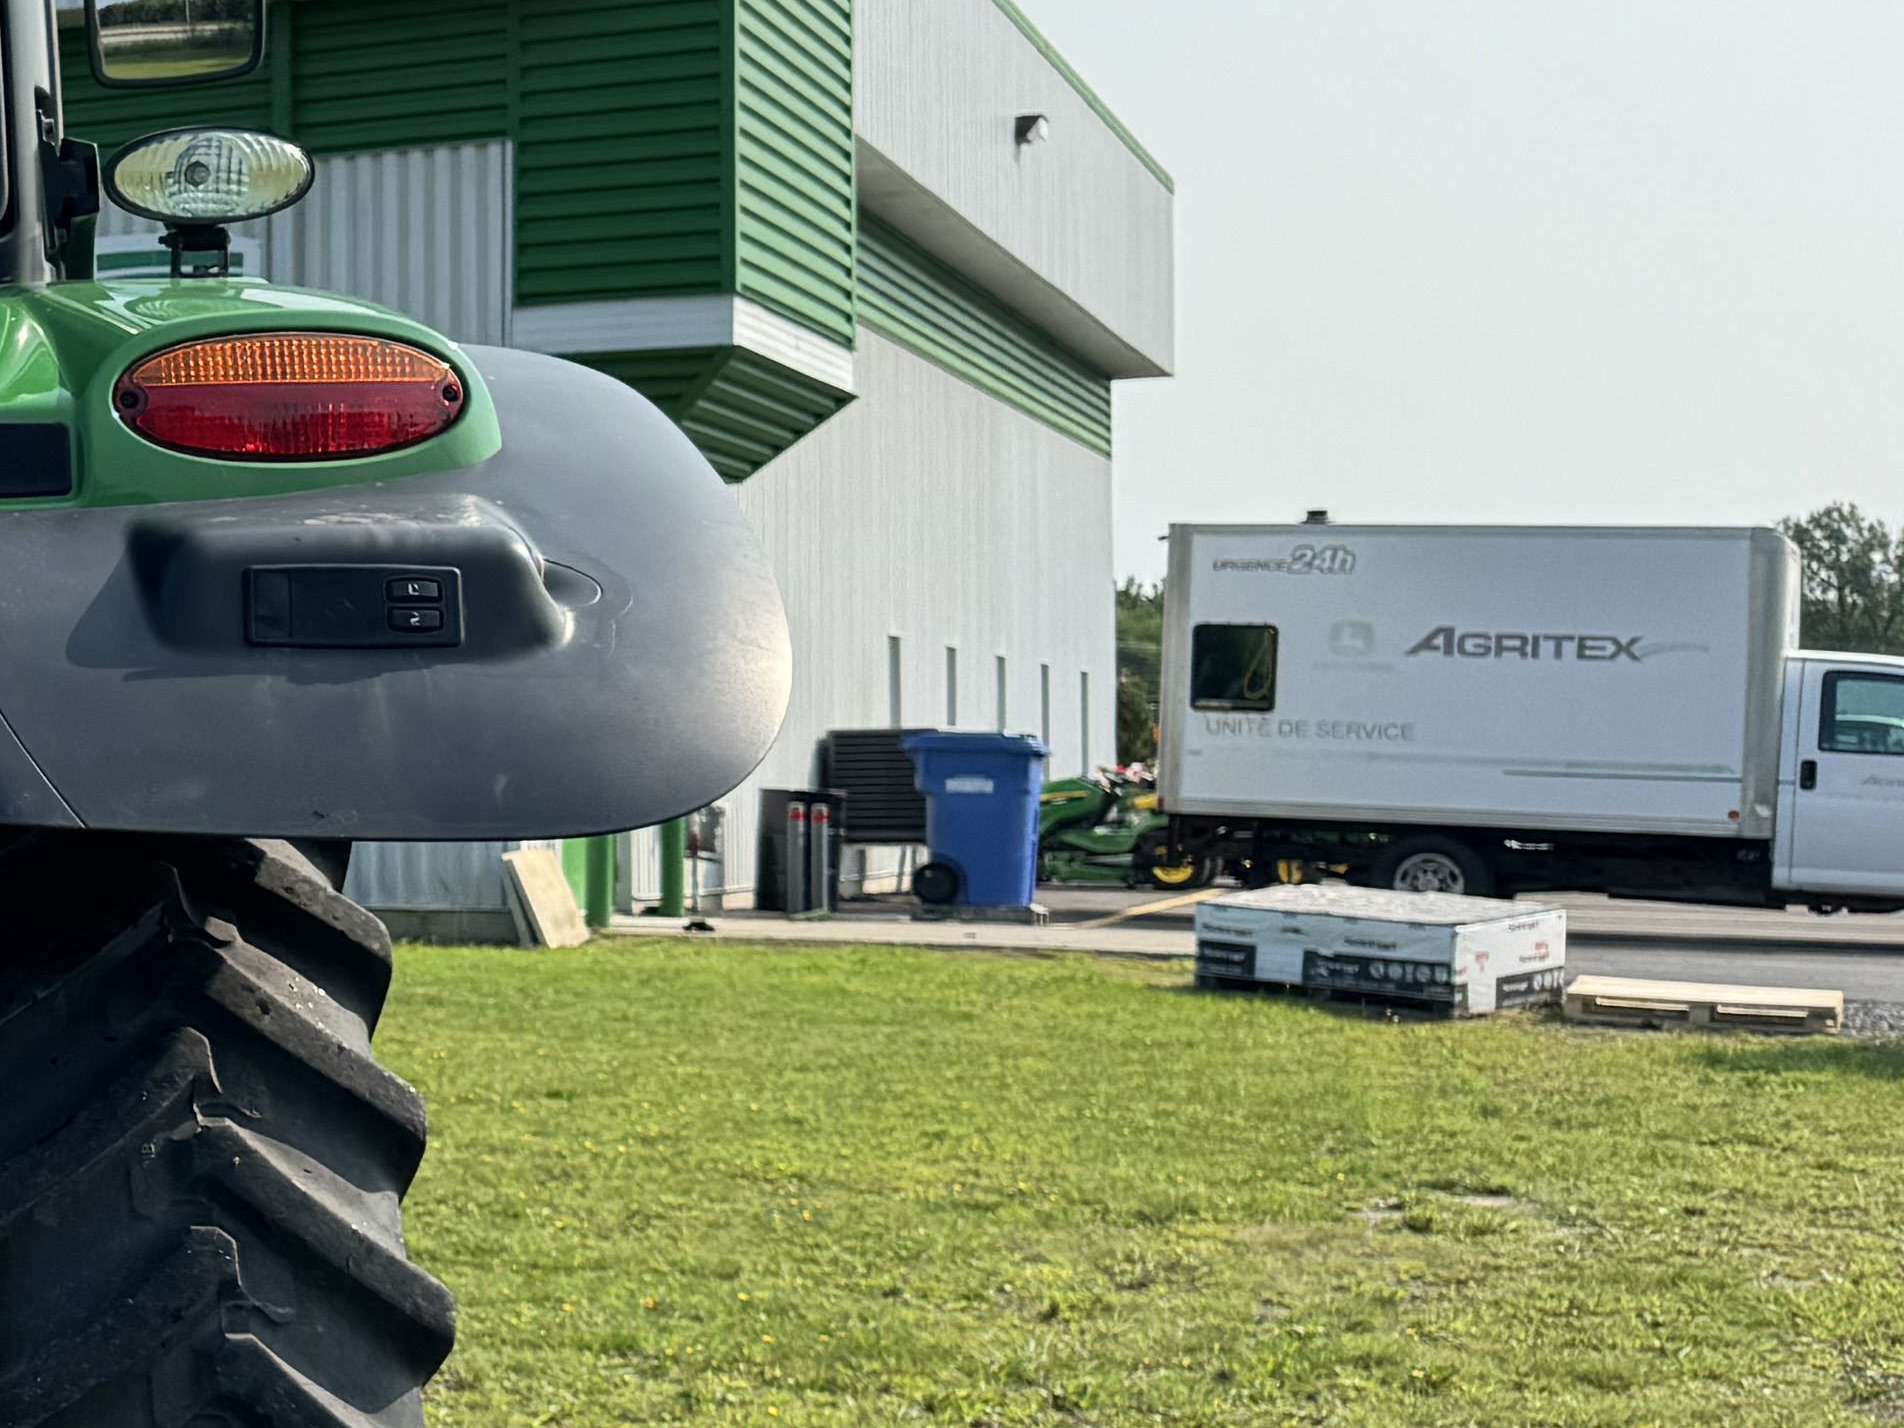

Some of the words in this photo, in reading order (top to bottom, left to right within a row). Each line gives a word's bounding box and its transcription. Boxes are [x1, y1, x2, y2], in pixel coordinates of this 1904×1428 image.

[1287, 544, 1356, 574] 24h
[1405, 625, 1645, 662] AGRITEX
[1279, 719, 1308, 739] DE
[1315, 720, 1416, 742] SERVICE
